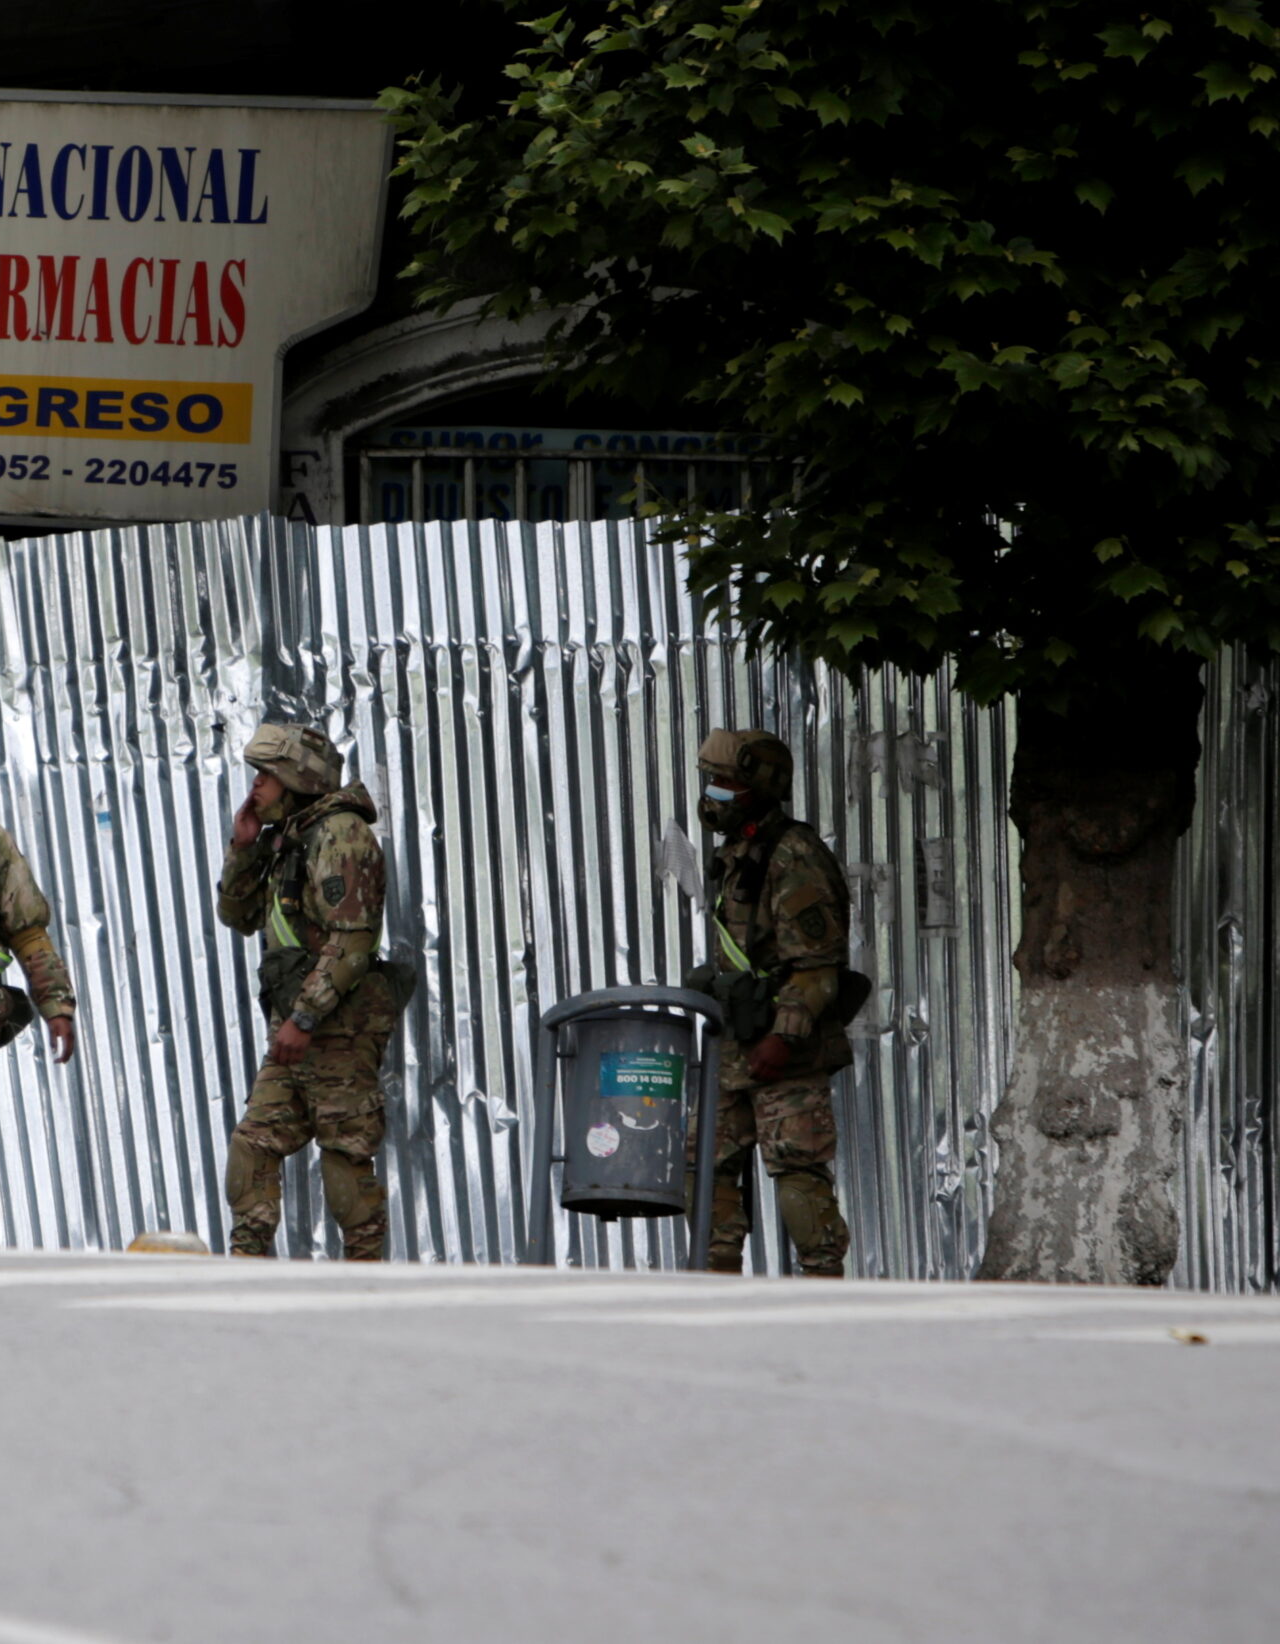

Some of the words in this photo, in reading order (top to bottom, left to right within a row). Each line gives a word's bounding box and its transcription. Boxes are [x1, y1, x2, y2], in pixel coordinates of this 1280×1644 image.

[84, 458, 238, 489] 2204475
[616, 1075, 638, 1084] 800
[640, 1075, 650, 1084] 14
